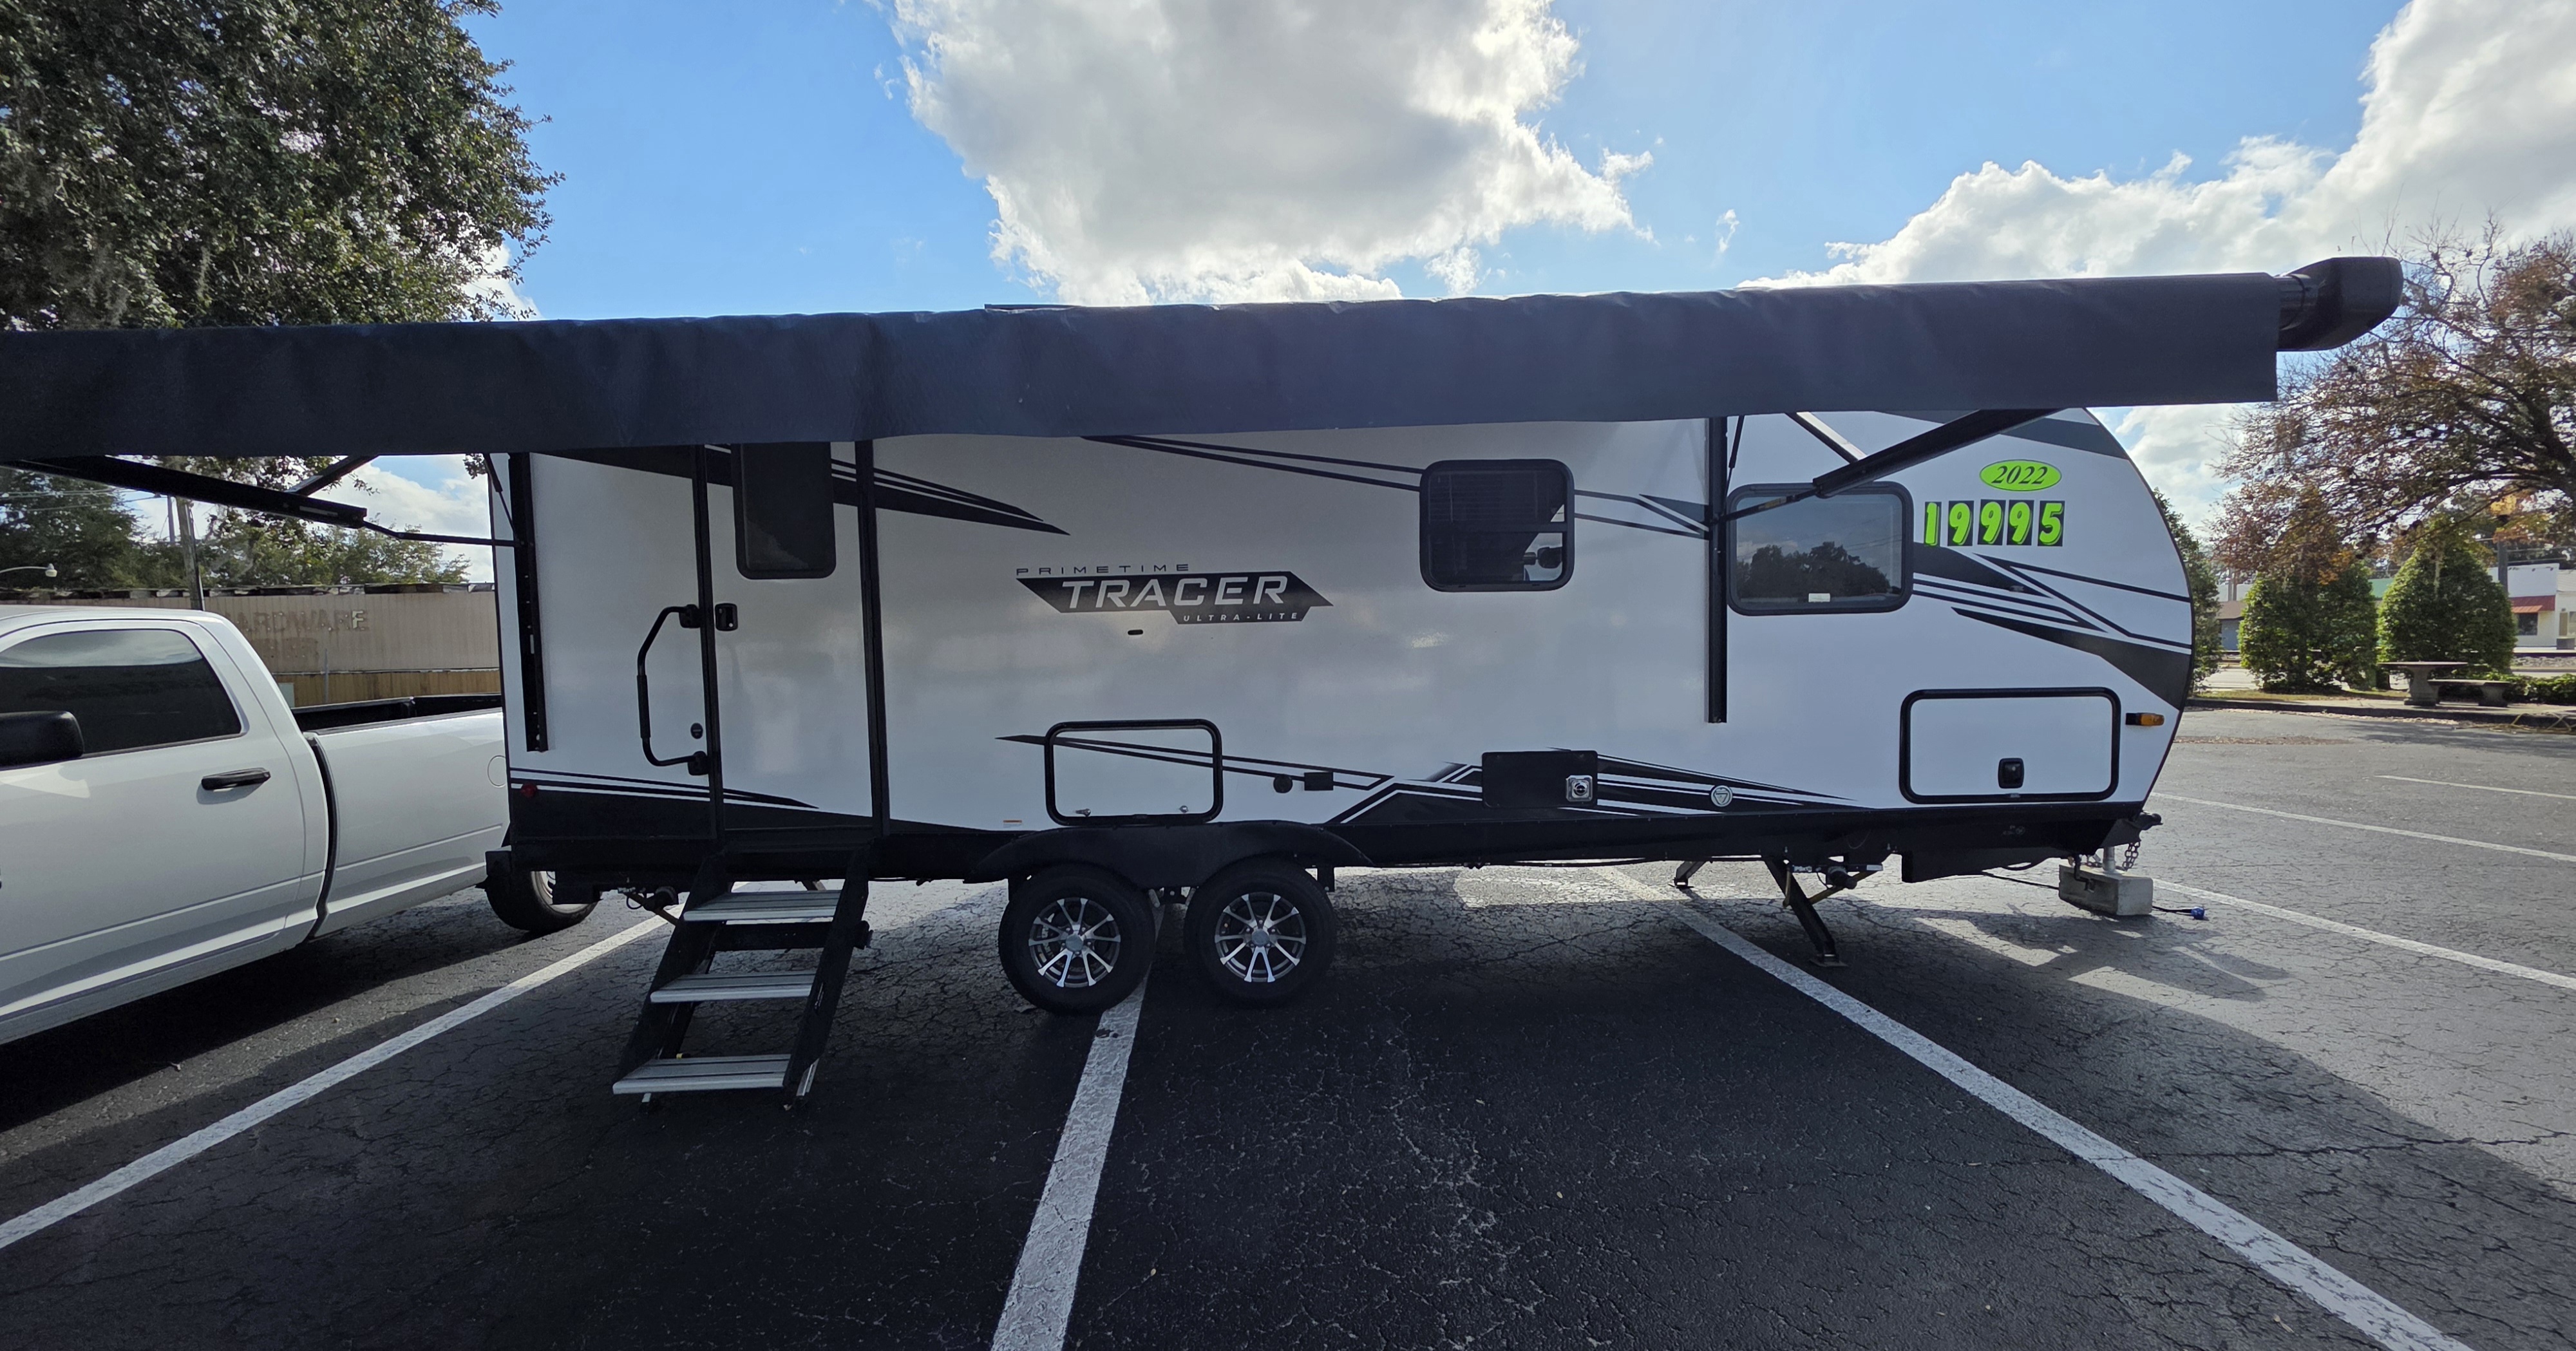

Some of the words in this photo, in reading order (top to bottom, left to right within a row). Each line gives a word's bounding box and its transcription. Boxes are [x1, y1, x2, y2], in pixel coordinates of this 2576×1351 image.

[1991, 466, 2048, 484] 2022
[1924, 501, 2063, 546] 19995
[1016, 564, 1188, 574] PRIMETIME
[1062, 576, 1289, 608] TRACER
[226, 609, 368, 633] ARDWARE
[1182, 612, 1298, 622] ULTRA-LITE
